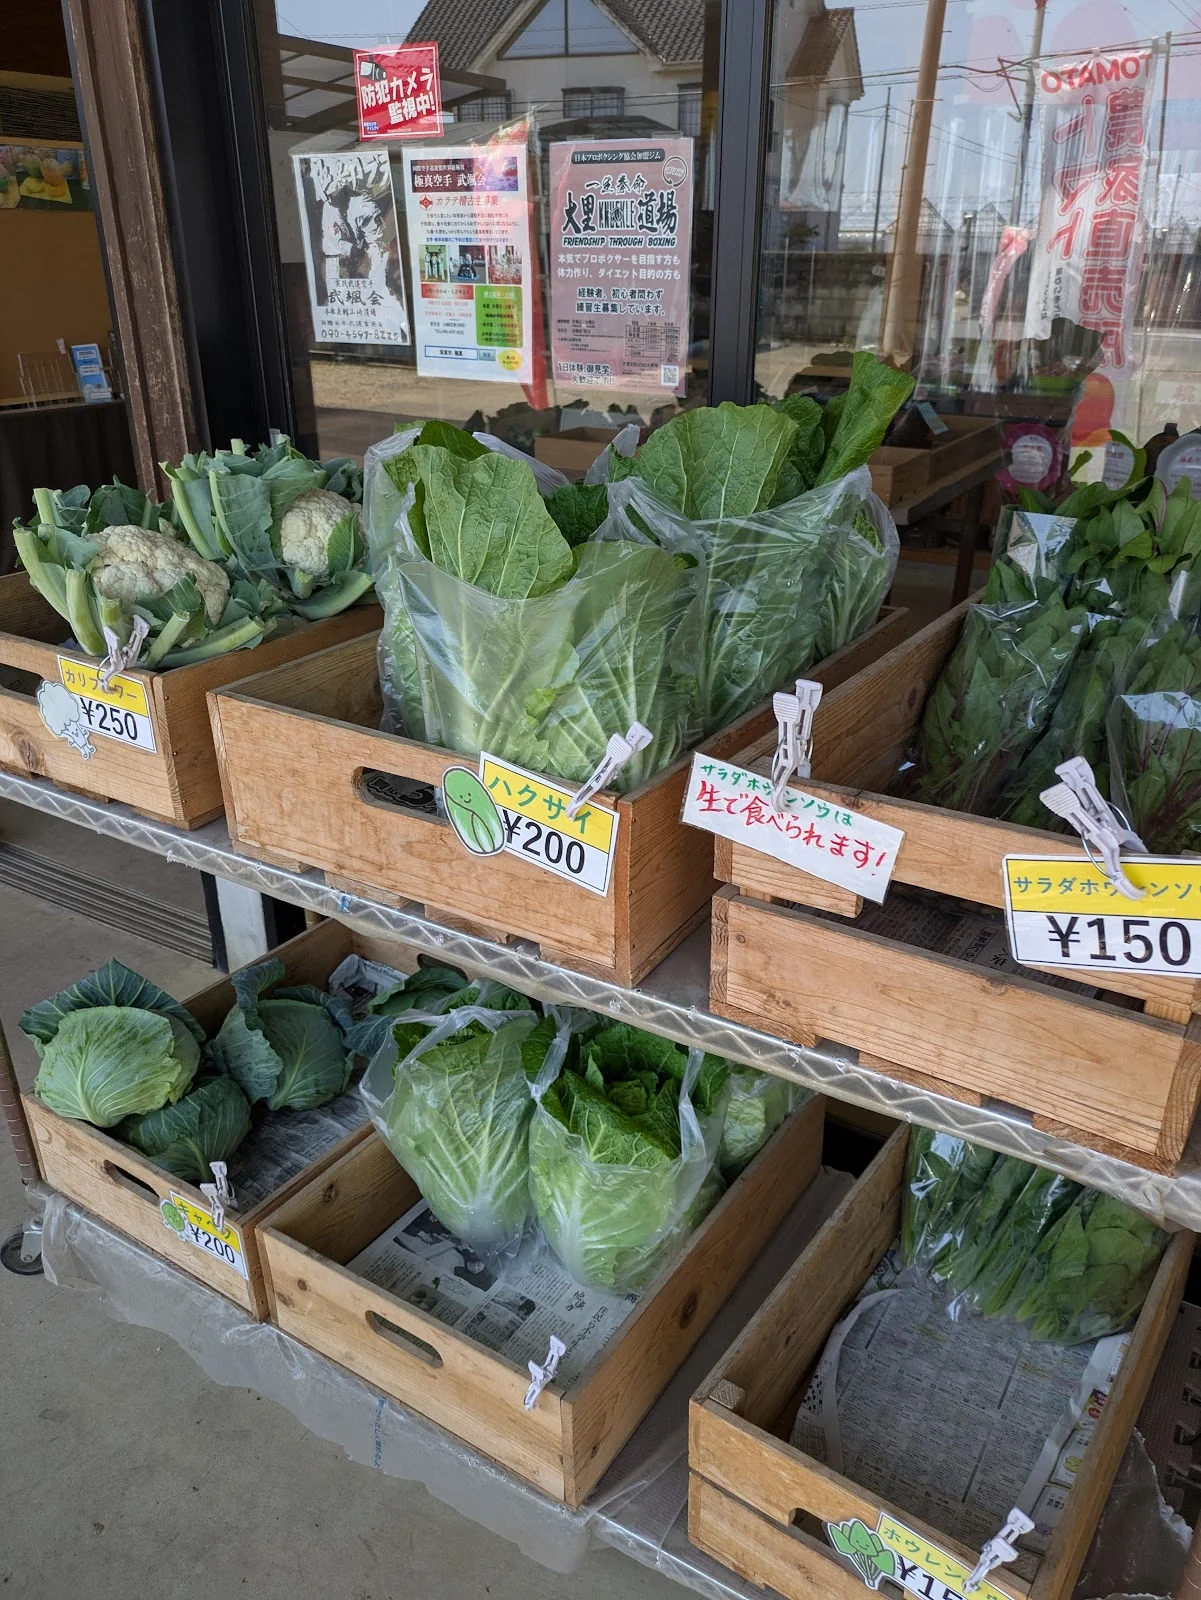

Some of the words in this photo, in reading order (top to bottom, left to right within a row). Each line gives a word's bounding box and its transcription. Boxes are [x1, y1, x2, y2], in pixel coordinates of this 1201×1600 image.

[361, 67, 434, 110] 防犯カメラ
[388, 91, 435, 125] 監視中!
[573, 150, 662, 163] 日本プロボクシング協会加盟ジム
[557, 253, 681, 266] 本気でプロボクサーを目指す方も
[563, 236, 606, 247] FRIENDSHIP
[609, 236, 644, 247] THROUGH
[647, 236, 677, 247] BOXING
[557, 267, 681, 280] 体力作り、ダイエット目的の方も
[576, 302, 666, 316] 練習生募集しています。
[577, 287, 664, 300] 経験者、初心者問わず
[65, 668, 138, 700] カリフワー
[79, 697, 139, 741] ¥250
[487, 776, 594, 835] ハクサイ
[699, 764, 854, 827] サラダホウンソウは
[502, 808, 586, 874] ¥200
[695, 780, 888, 876] 生で食べられます!
[1044, 914, 1192, 967] ¥150
[188, 1223, 235, 1264] ¥200
